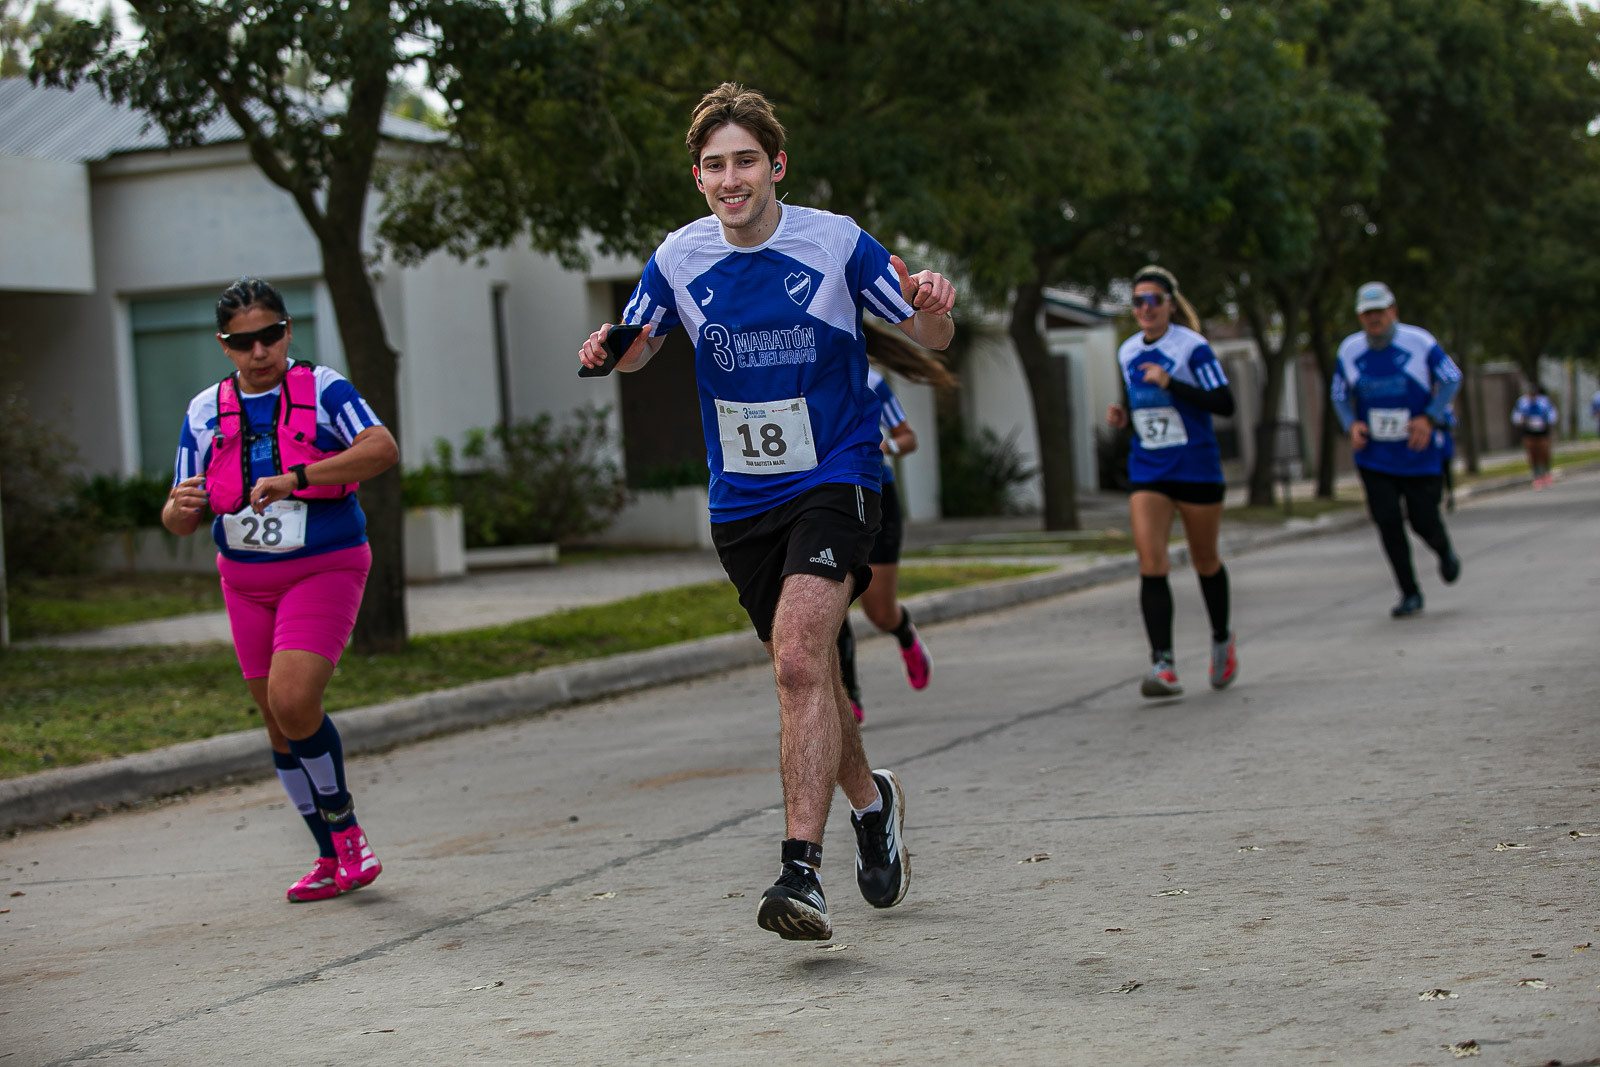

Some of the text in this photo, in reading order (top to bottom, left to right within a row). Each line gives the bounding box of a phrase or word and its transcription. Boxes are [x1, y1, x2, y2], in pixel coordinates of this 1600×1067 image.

[704, 323, 816, 372] 3 MARATÓN
[737, 348, 817, 368] C.A.BELGRANO
[737, 423, 787, 457] 18
[241, 516, 283, 546] 28
[809, 556, 837, 568] adidas
